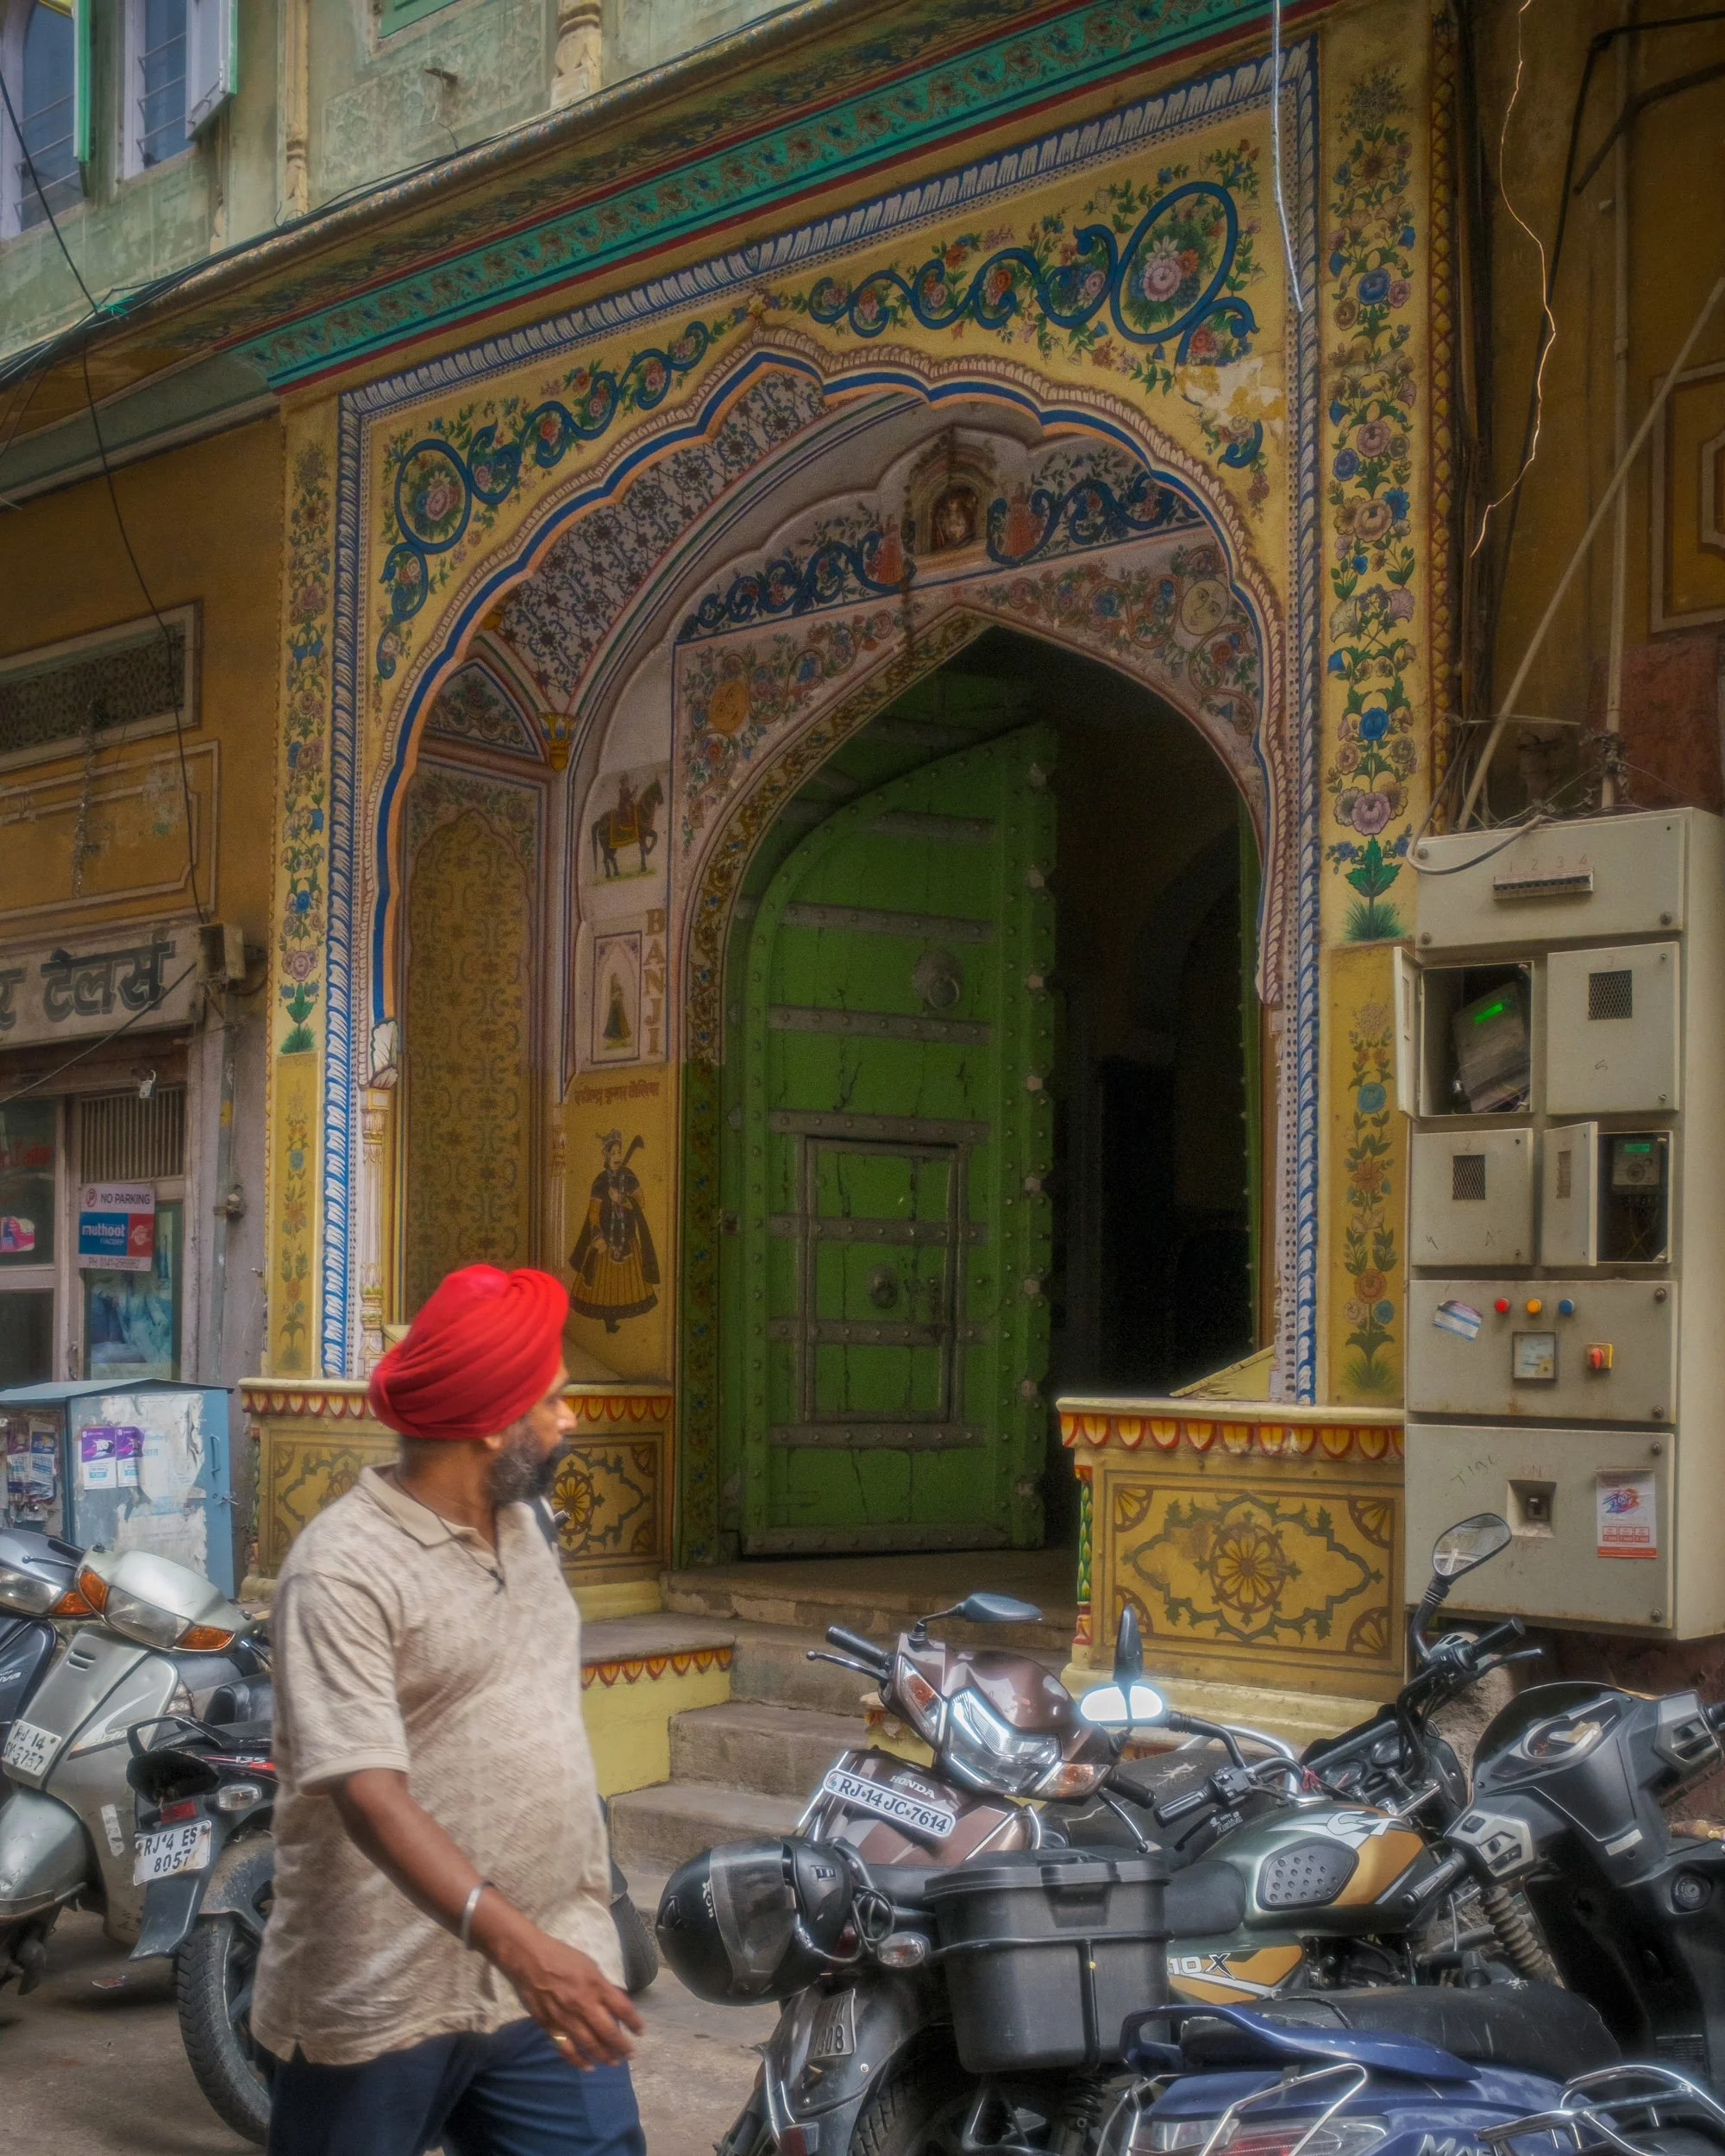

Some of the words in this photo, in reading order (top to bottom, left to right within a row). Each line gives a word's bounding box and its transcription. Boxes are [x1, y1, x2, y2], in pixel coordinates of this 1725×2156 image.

[643, 908, 666, 1054] BANJI
[101, 1193, 113, 1204] NO
[115, 1194, 151, 1205] PARKING
[82, 1223, 125, 1237] muthoot
[890, 1777, 936, 1799] HONDA
[154, 1849, 191, 1872] 8057
